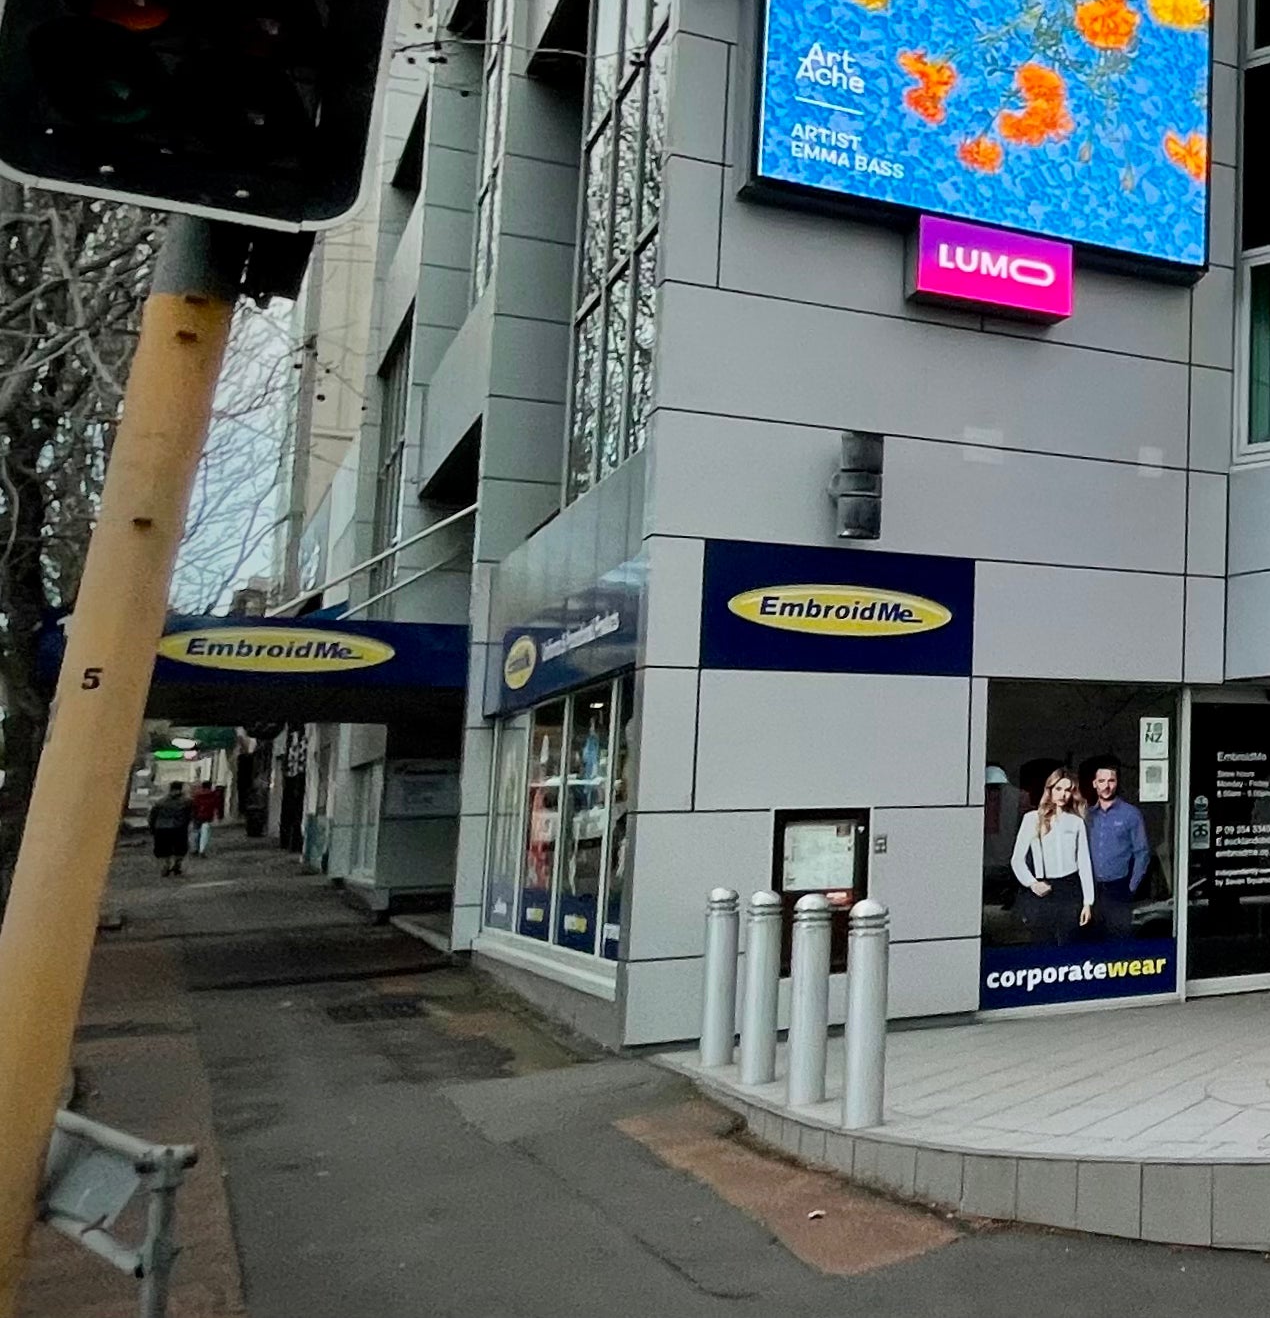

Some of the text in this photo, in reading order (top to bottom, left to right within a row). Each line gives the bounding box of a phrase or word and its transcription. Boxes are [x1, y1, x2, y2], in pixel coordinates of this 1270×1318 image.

[800, 42, 856, 73] Art
[796, 57, 865, 94] Ache
[791, 123, 862, 151] ARTIST
[791, 140, 905, 179] EMMA BASS
[938, 243, 1055, 287] LUMO
[760, 596, 923, 623] EmbroidMe
[186, 638, 363, 660] EmbroidMe
[81, 667, 103, 690] 5
[986, 958, 1167, 992] corporatewear
